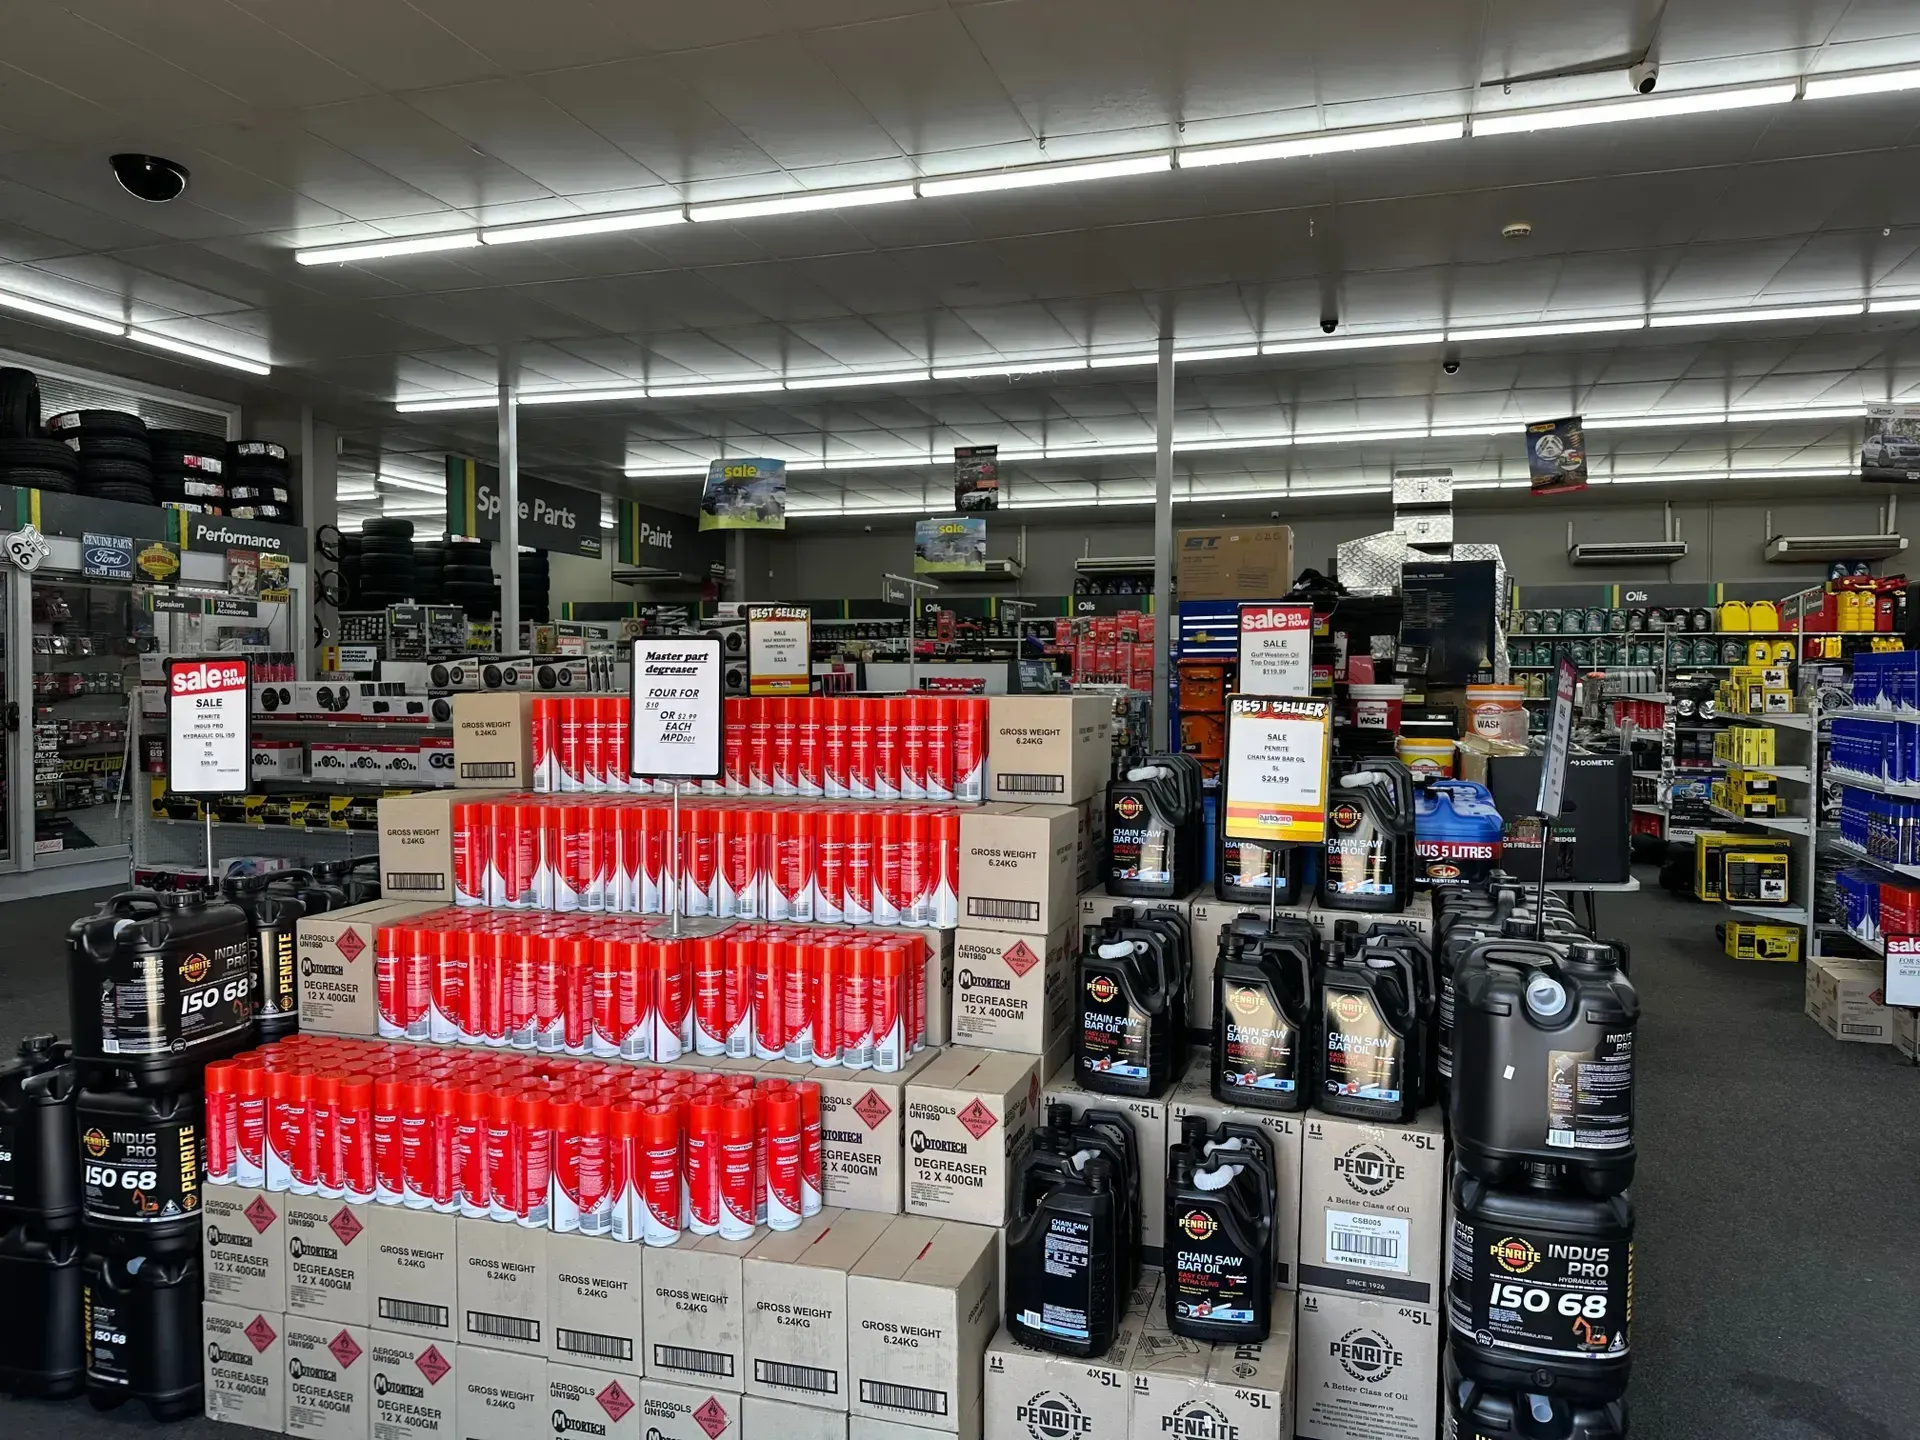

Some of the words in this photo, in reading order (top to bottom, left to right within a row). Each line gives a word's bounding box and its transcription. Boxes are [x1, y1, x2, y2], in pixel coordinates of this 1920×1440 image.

[724, 464, 757, 479] sale
[477, 486, 528, 520] Spe
[533, 499, 576, 529] Parts
[640, 523, 673, 549] Paint
[938, 524, 965, 534] sale
[28, 528, 49, 555] ROUTE
[83, 534, 112, 548] GENUINE
[113, 538, 132, 550] PARTS
[196, 525, 280, 549] Performance
[11, 542, 33, 565] 66
[25, 540, 36, 553] US
[94, 550, 122, 565] Ford
[85, 566, 107, 576] USED
[109, 569, 131, 578] HERE
[1626, 591, 1648, 601] Oils
[156, 600, 185, 609] Speakers
[925, 604, 941, 613] Oils
[1078, 602, 1095, 611] Oils
[216, 608, 249, 616] Accessories
[750, 607, 773, 619] BEST
[775, 607, 807, 619] SELLER
[1242, 609, 1287, 629] sale
[1288, 619, 1309, 627] now
[1263, 640, 1287, 648] SALE
[646, 652, 682, 661] Master
[685, 653, 708, 663] part
[222, 668, 238, 678] on
[646, 664, 698, 676] degreaser
[173, 664, 222, 692] sale
[223, 676, 246, 686] now
[649, 688, 677, 698] FOUR
[680, 689, 700, 698] FOR
[196, 699, 223, 708] SALE
[646, 701, 659, 709] $10
[1232, 699, 1268, 713] BEST
[1273, 701, 1326, 717] SELLER
[660, 711, 676, 719] OR
[1359, 716, 1385, 725] WASH
[665, 722, 692, 731] EACH
[1262, 775, 1290, 783] $24.99
[1415, 844, 1439, 856] NUS
[1442, 846, 1449, 857] 5
[1452, 846, 1492, 859] LITRES
[214, 942, 248, 960] INDUS
[1888, 938, 1920, 952] sale
[179, 959, 211, 975] PENRITE
[278, 933, 293, 994] PENRITE
[181, 988, 219, 1015] ISO
[223, 979, 249, 1001] 68
[910, 1103, 956, 1115] AEROSOLS
[910, 1111, 940, 1121] UN1950
[83, 1135, 110, 1148] PENRITE
[113, 1132, 156, 1145] INDUS
[910, 1130, 968, 1154] MOTORTECH
[1401, 1133, 1436, 1151] 4X5L
[126, 1145, 156, 1157] PRO
[179, 1125, 197, 1193] PENRITE
[914, 1157, 987, 1176] DEGREASER
[1334, 1157, 1405, 1180] PENRITE
[85, 1165, 117, 1187] ISO
[121, 1171, 157, 1190] 68
[919, 1170, 929, 1180] 12
[934, 1171, 942, 1182] X
[944, 1173, 983, 1187] 400GM
[1327, 1195, 1334, 1203] A
[1336, 1197, 1361, 1208] Better
[1362, 1200, 1385, 1211] Class
[1386, 1204, 1395, 1212] of
[1397, 1205, 1410, 1213] Oil
[1178, 1218, 1218, 1231] PENRITE
[1352, 1216, 1382, 1227] CSB005
[1177, 1251, 1213, 1265] CHAIN
[1214, 1256, 1243, 1268] SAW
[1490, 1245, 1541, 1263] PENRITE
[1548, 1244, 1609, 1262] INDUS
[1177, 1260, 1202, 1271] BAR
[1204, 1264, 1222, 1275] OIL
[1341, 1256, 1366, 1265] PENRITE
[1178, 1272, 1196, 1280] EASY
[1567, 1262, 1609, 1278] PRO
[559, 1274, 590, 1285] GROSS
[591, 1278, 628, 1290] WEIGHT
[1178, 1278, 1200, 1286] EXTRA
[1200, 1280, 1219, 1288] CLING
[1346, 1279, 1367, 1288] SINCE
[1368, 1281, 1385, 1290] 1926
[1558, 1277, 1593, 1285] HYDRAULIC
[1490, 1283, 1550, 1312] ISO
[1558, 1294, 1607, 1319] 68
[862, 1320, 898, 1334] GROSS
[900, 1325, 942, 1339] WEIGHT
[1489, 1326, 1516, 1335] ANTI-WEAR
[1517, 1331, 1553, 1341] FORMULATION
[1501, 1323, 1523, 1331] QUALITY
[94, 1330, 110, 1342] ISO
[112, 1333, 126, 1344] 68
[883, 1335, 919, 1348] 6.24KG
[1477, 1333, 1492, 1341] Since
[1330, 1341, 1403, 1367] PENRITE
[1087, 1368, 1121, 1388] 4X5L
[1016, 1405, 1092, 1432] PENRITE
[1162, 1415, 1239, 1440] PENRITE
